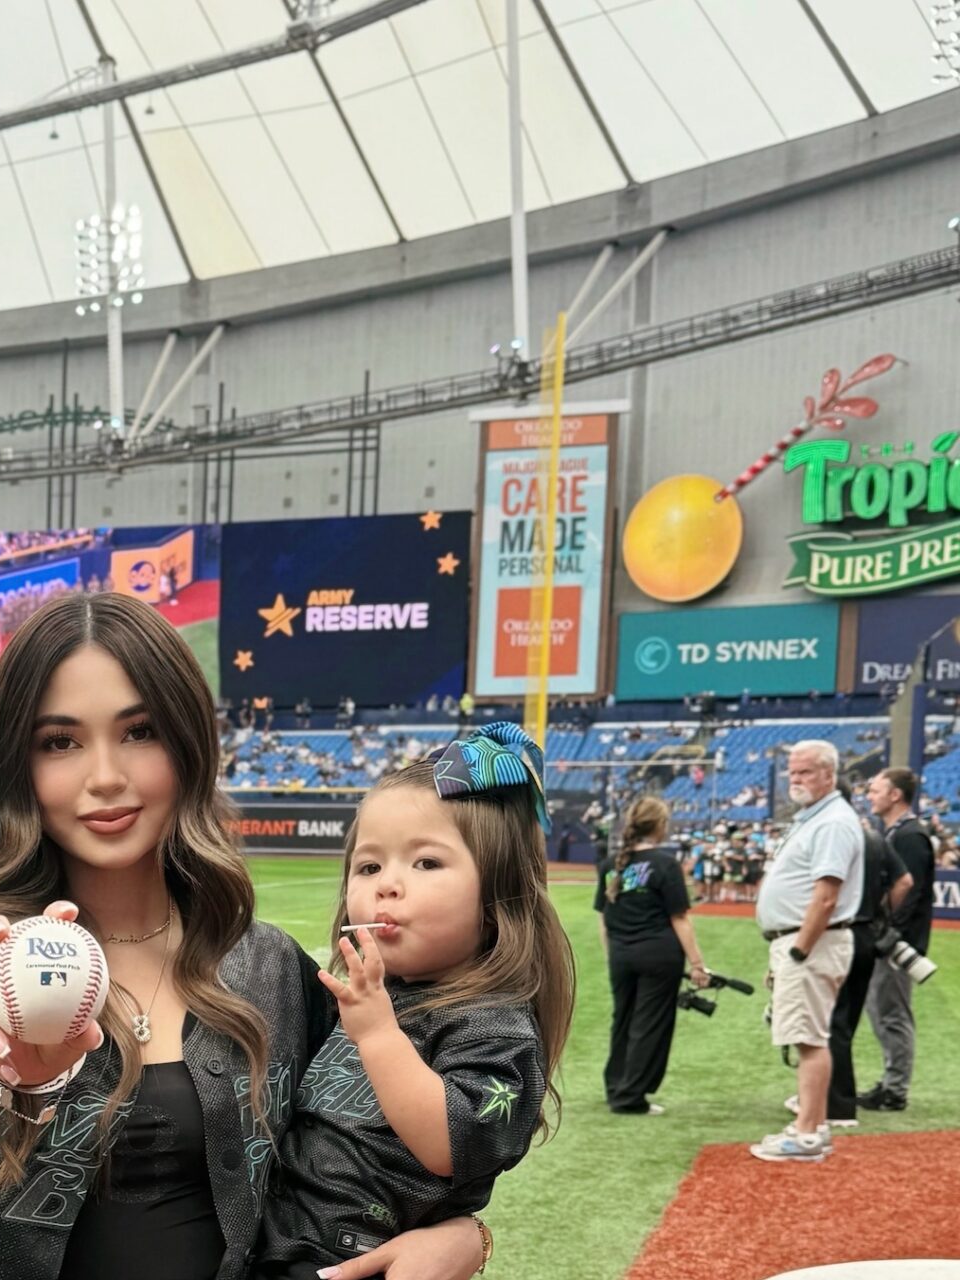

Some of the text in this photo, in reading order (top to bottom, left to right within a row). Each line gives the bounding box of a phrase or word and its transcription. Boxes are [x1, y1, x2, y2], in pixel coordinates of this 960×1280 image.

[501, 475, 588, 517] CARE
[809, 551, 893, 586] PURE
[307, 589, 355, 607] ARMY
[305, 602, 430, 632] RESERVE
[677, 637, 819, 664] TD SYNNEX
[862, 660, 932, 684] DREA
[297, 819, 345, 837] BANK
